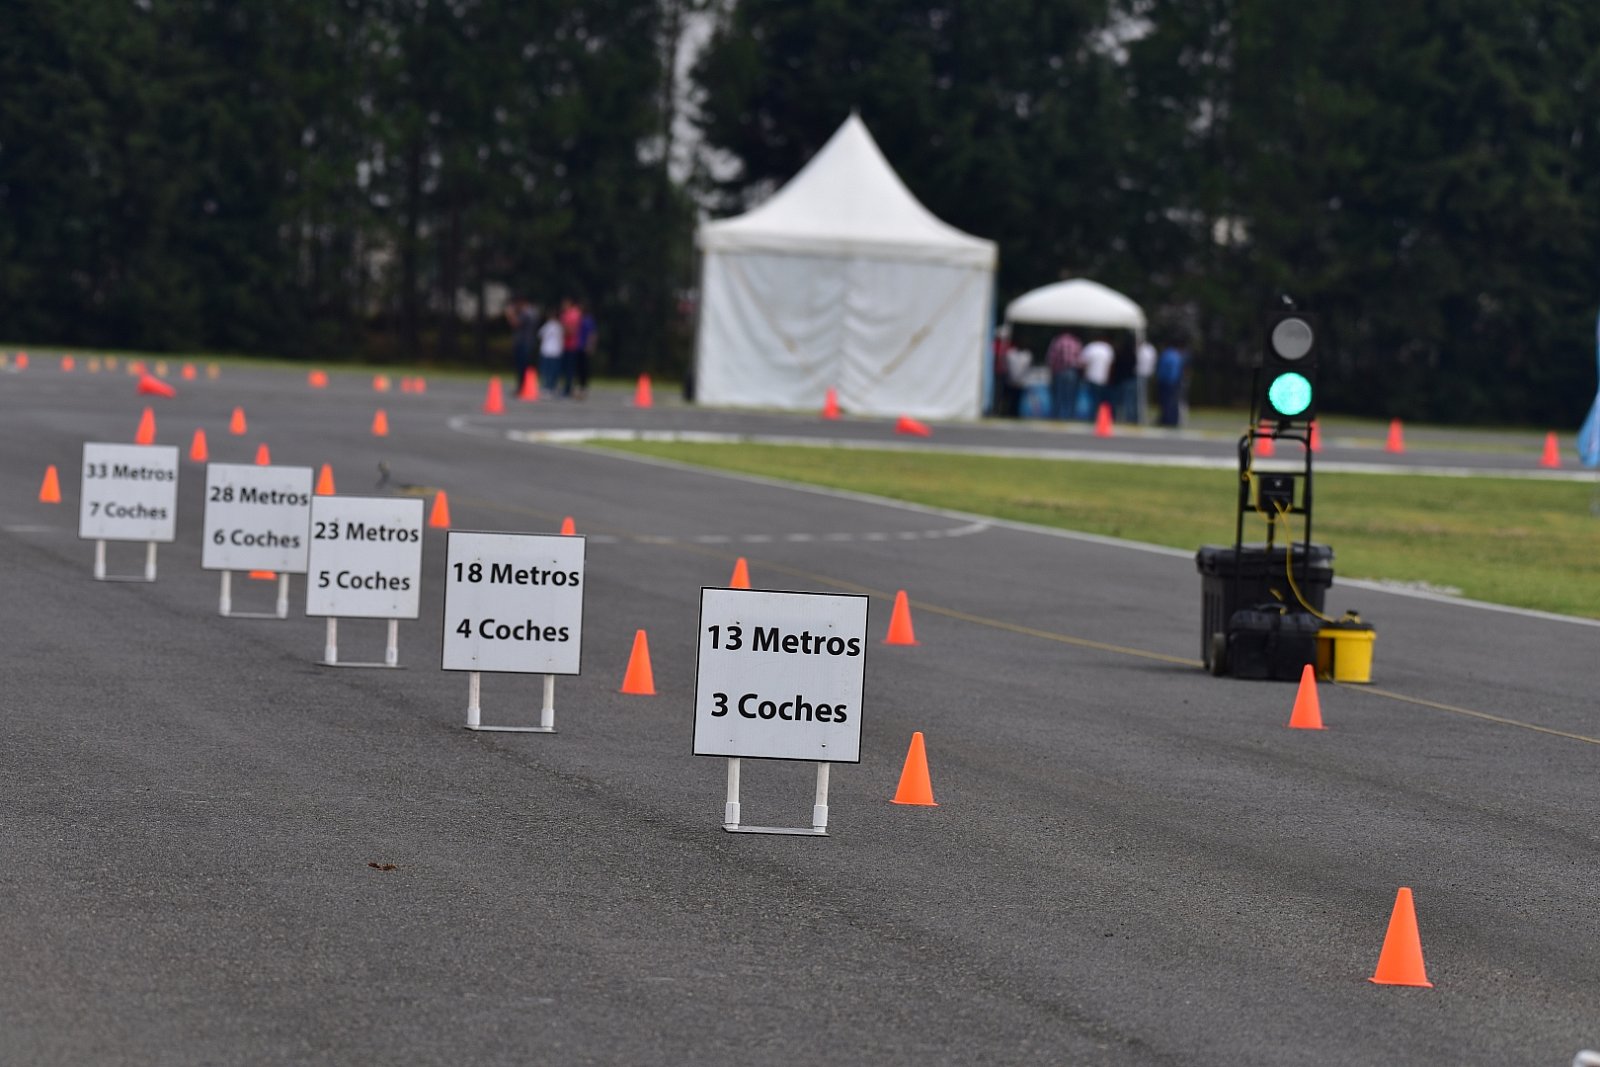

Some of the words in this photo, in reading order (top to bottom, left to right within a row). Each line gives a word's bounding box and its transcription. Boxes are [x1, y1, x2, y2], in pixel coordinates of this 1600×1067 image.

[86, 463, 107, 479] 33
[113, 465, 174, 481] Metros
[209, 485, 233, 502] 28
[240, 488, 308, 506] Metros
[90, 501, 100, 516] 7
[105, 502, 167, 519] Coches
[212, 529, 225, 545] 6
[231, 529, 300, 548] Coches
[314, 521, 339, 539] 23
[347, 523, 418, 542] Metros
[318, 570, 329, 588] 5
[337, 571, 410, 590] Coches
[453, 562, 482, 583] 18
[491, 563, 579, 586] Metros
[456, 618, 471, 638] 4
[479, 619, 569, 642] Coches
[708, 625, 742, 650] 13
[753, 627, 860, 656] Metros
[710, 692, 728, 717] 3
[738, 694, 847, 723] Coches
